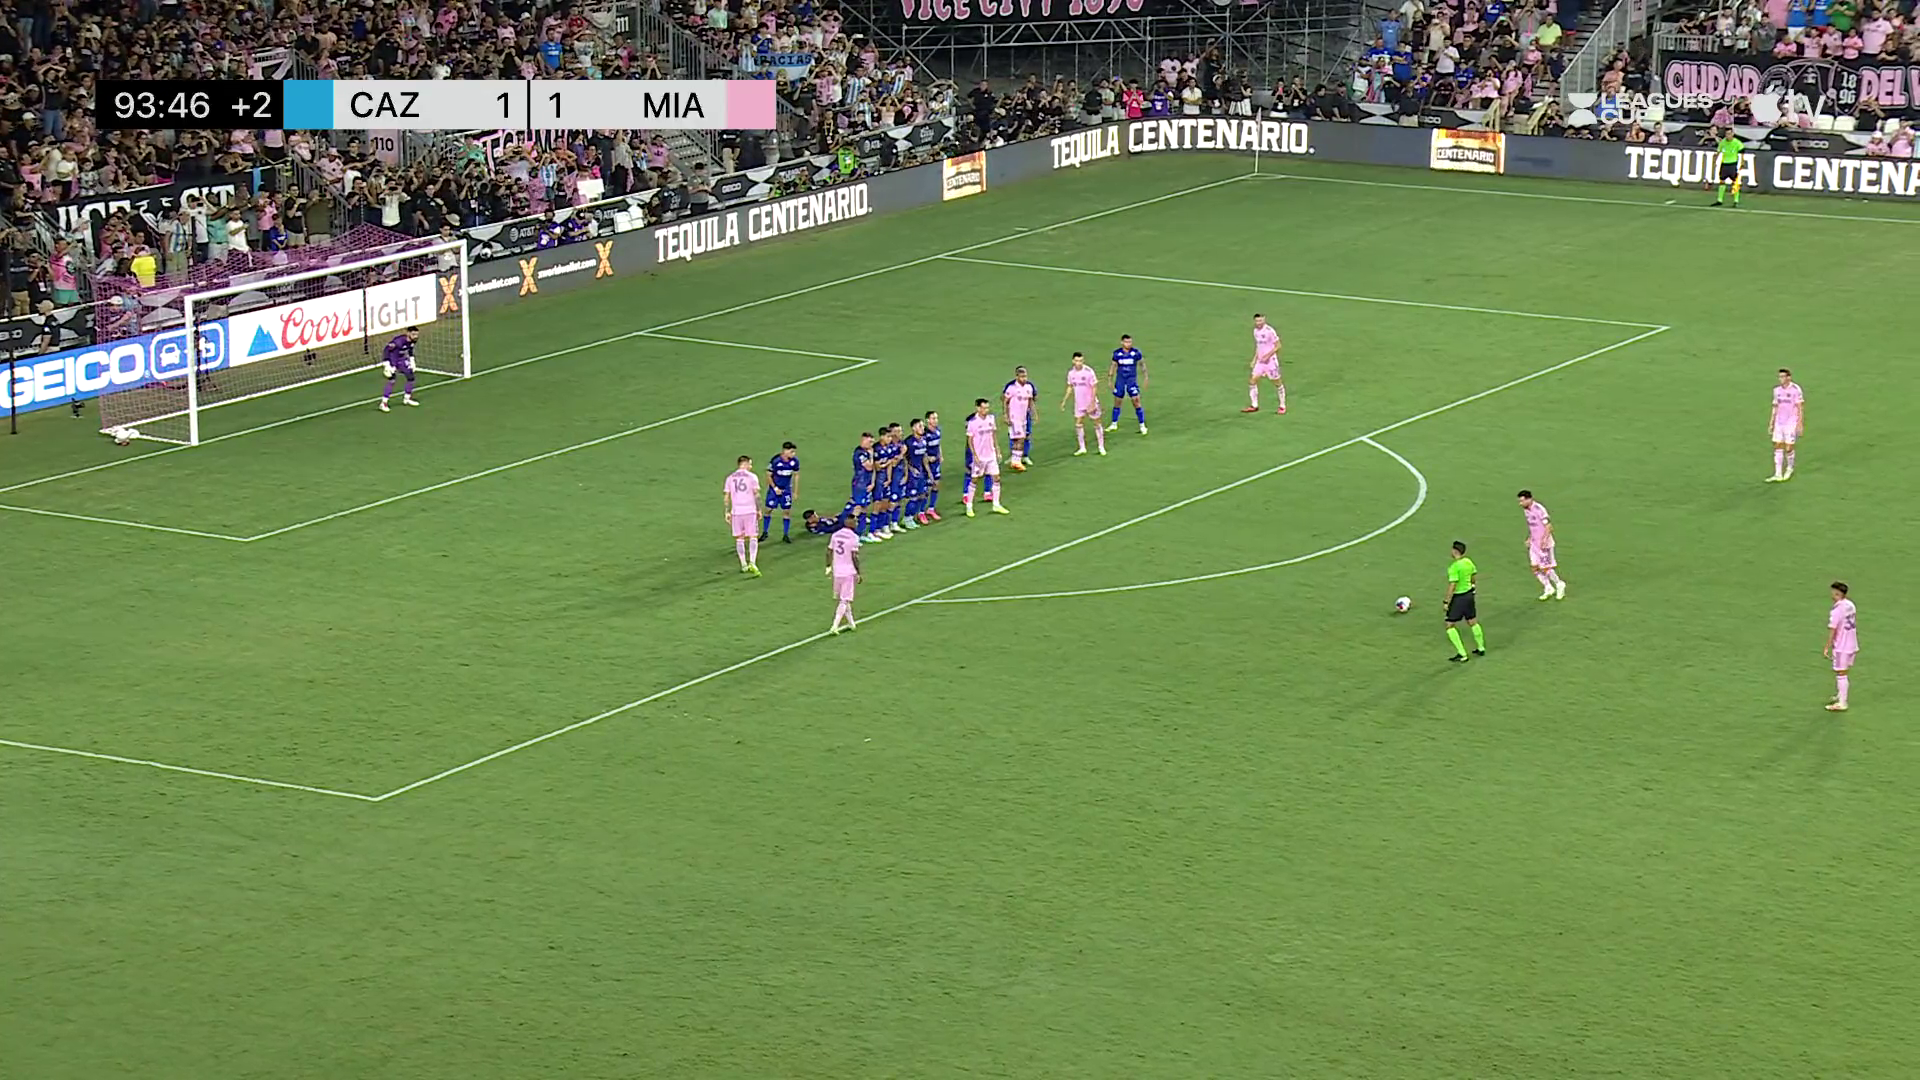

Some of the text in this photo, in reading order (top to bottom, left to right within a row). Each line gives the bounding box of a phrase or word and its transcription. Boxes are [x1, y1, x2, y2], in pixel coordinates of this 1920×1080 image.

[1665, 61, 1760, 105] CIUDAD
[1859, 66, 1908, 110] DEL
[374, 136, 394, 152] 110
[1051, 118, 1315, 169] TEQUILA CENTENARIO.
[655, 183, 873, 264] TEQUILA CENTENARIO.
[280, 295, 421, 350] Coors LIGHT
[0, 344, 146, 409] GEICO
[733, 478, 748, 493] 16
[835, 541, 846, 555] 3
